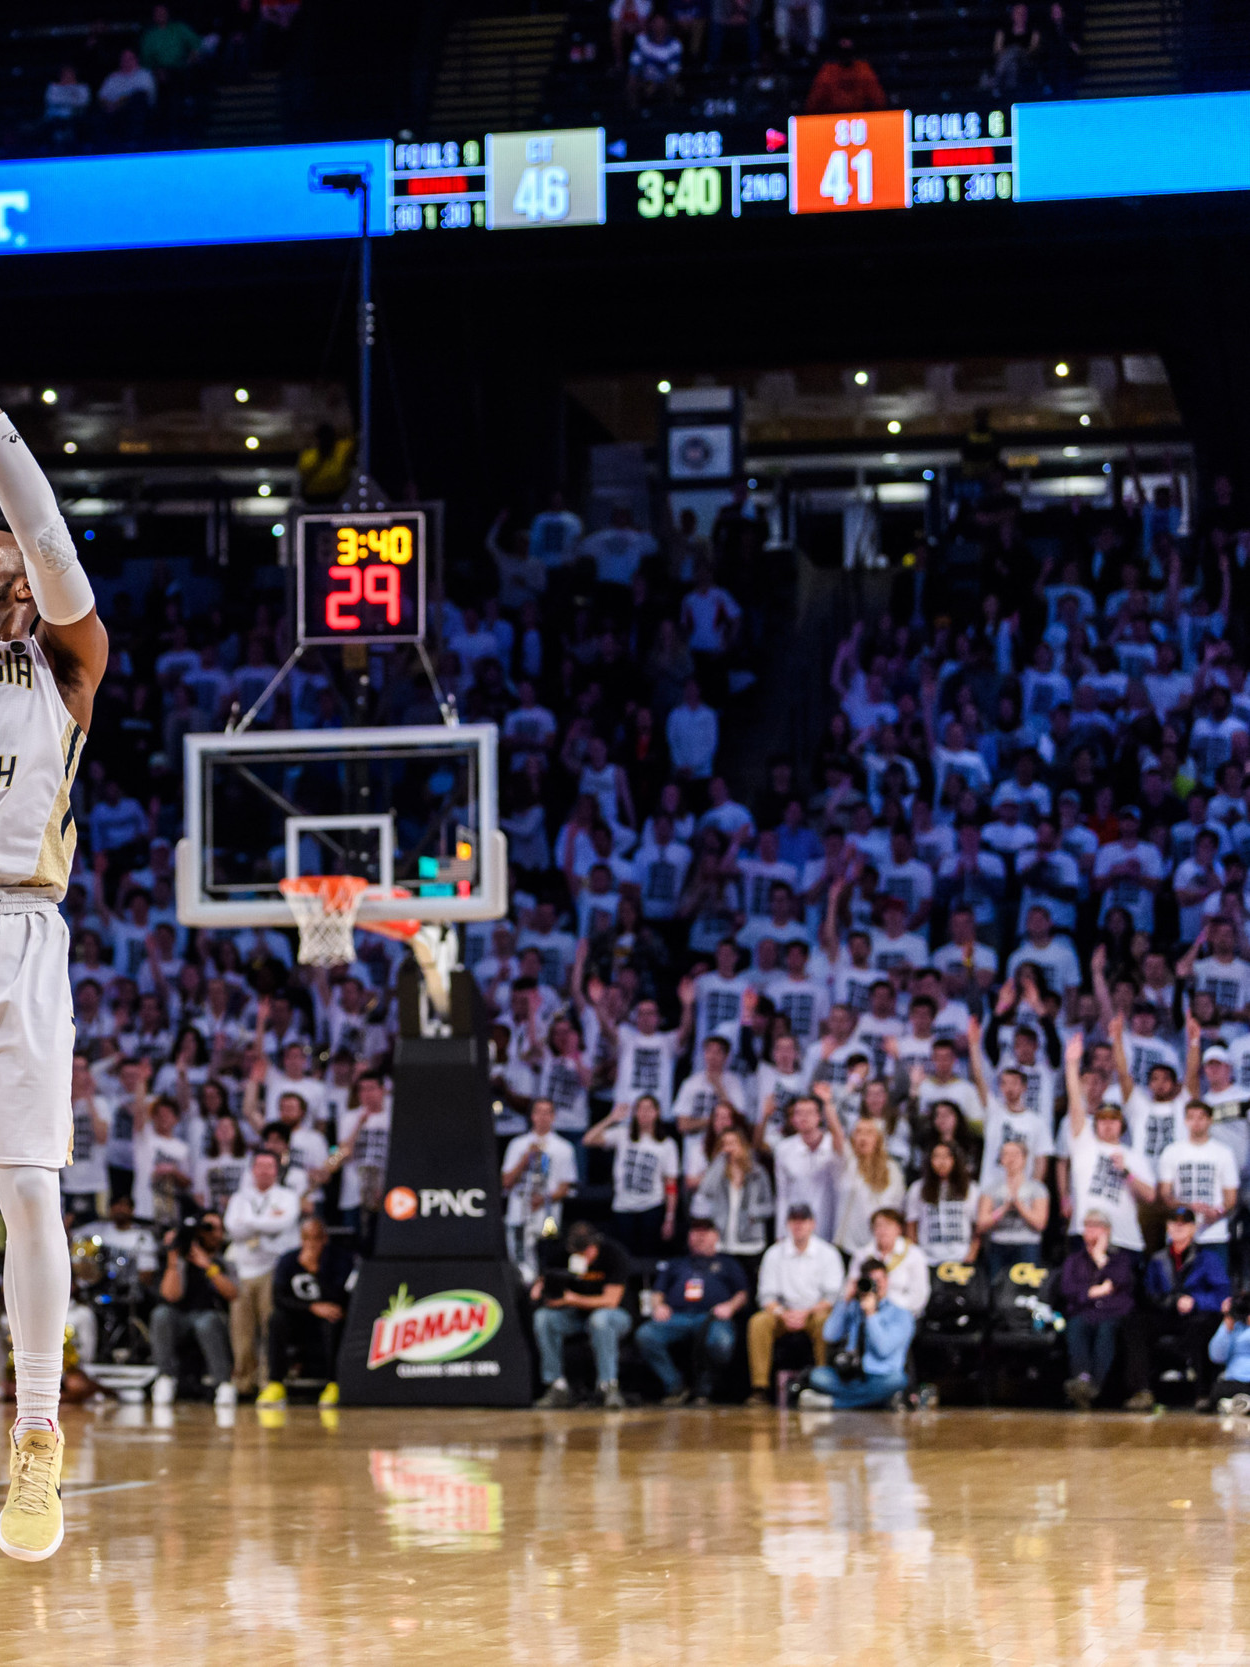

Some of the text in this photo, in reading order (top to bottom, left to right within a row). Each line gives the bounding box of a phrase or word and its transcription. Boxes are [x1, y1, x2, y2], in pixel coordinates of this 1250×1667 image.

[835, 119, 867, 146] SU
[915, 112, 981, 141] FOULS
[395, 141, 460, 170] FOULS
[665, 131, 723, 160] POSS
[513, 166, 570, 222] 46
[637, 167, 787, 218] 3:40 2ND
[820, 149, 873, 206] 41
[947, 174, 960, 202] 1
[337, 526, 412, 565] 3:40
[325, 564, 401, 630] 29
[419, 1188, 487, 1217] PNC
[368, 1303, 488, 1362] LIBMAN
